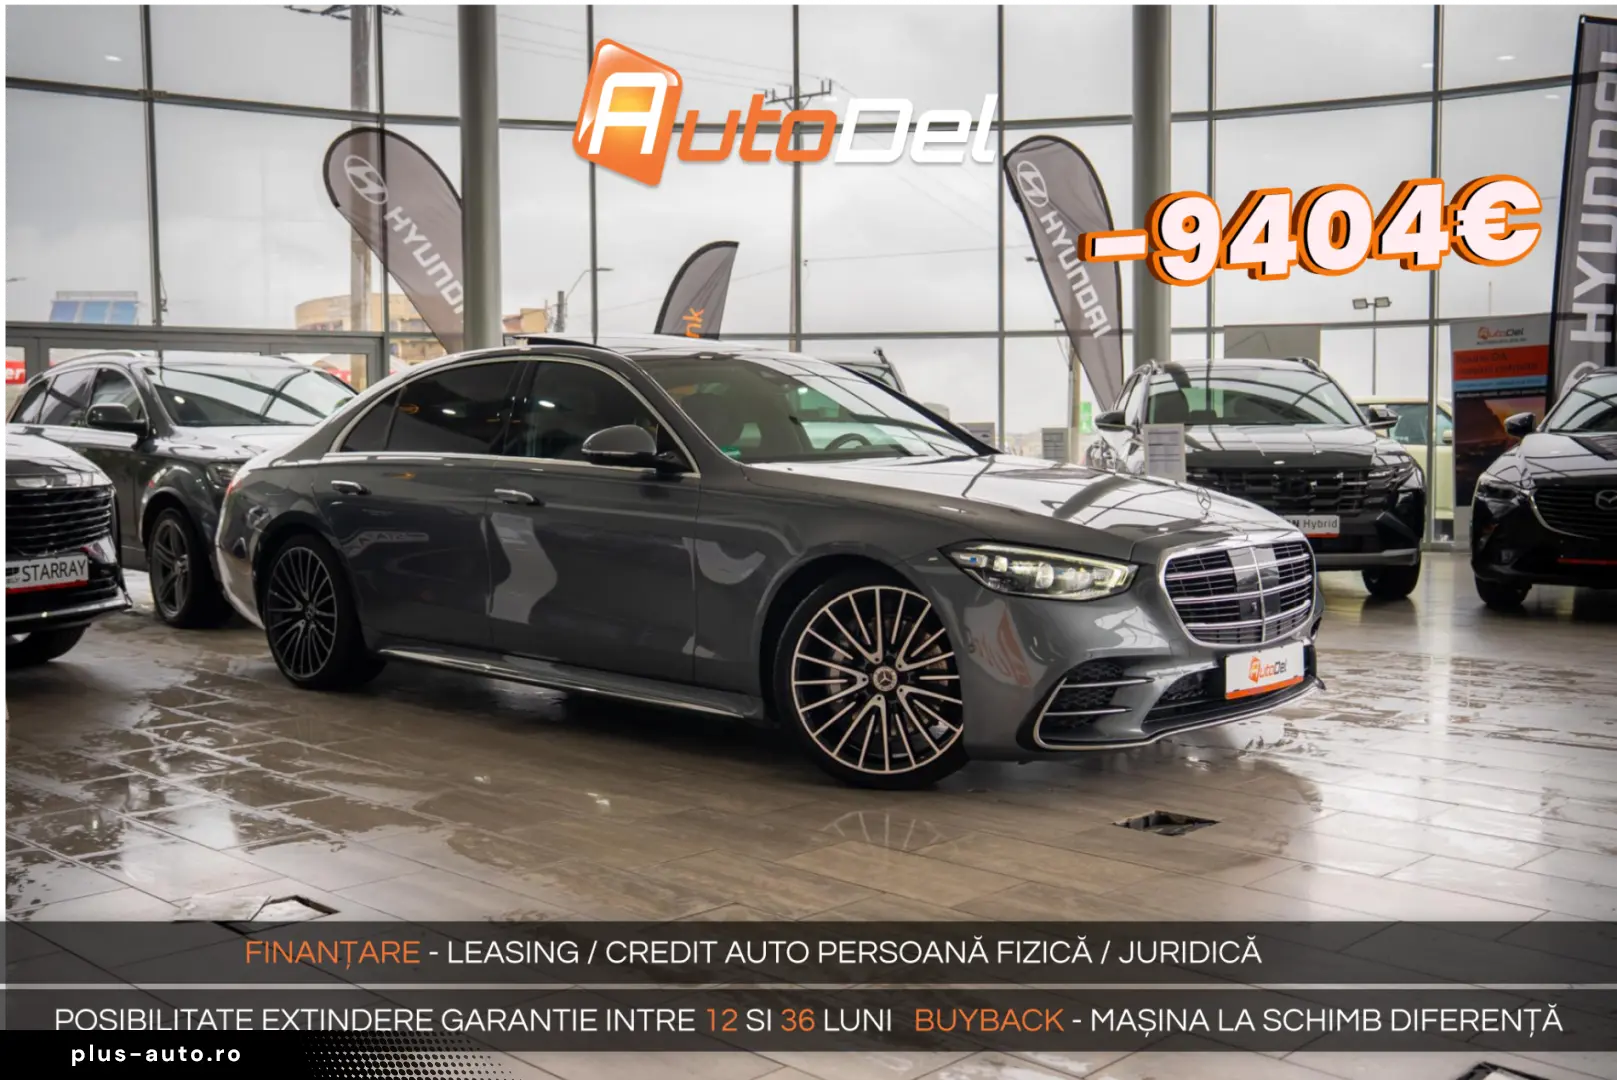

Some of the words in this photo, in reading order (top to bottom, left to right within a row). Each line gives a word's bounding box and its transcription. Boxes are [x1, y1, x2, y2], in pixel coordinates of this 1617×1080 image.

[384, 206, 464, 314] HYUND
[1040, 210, 1112, 339] HYUNDAI
[1303, 518, 1338, 530] Hybrid
[22, 560, 86, 582] STARRAY
[1248, 656, 1288, 683] AutoDel
